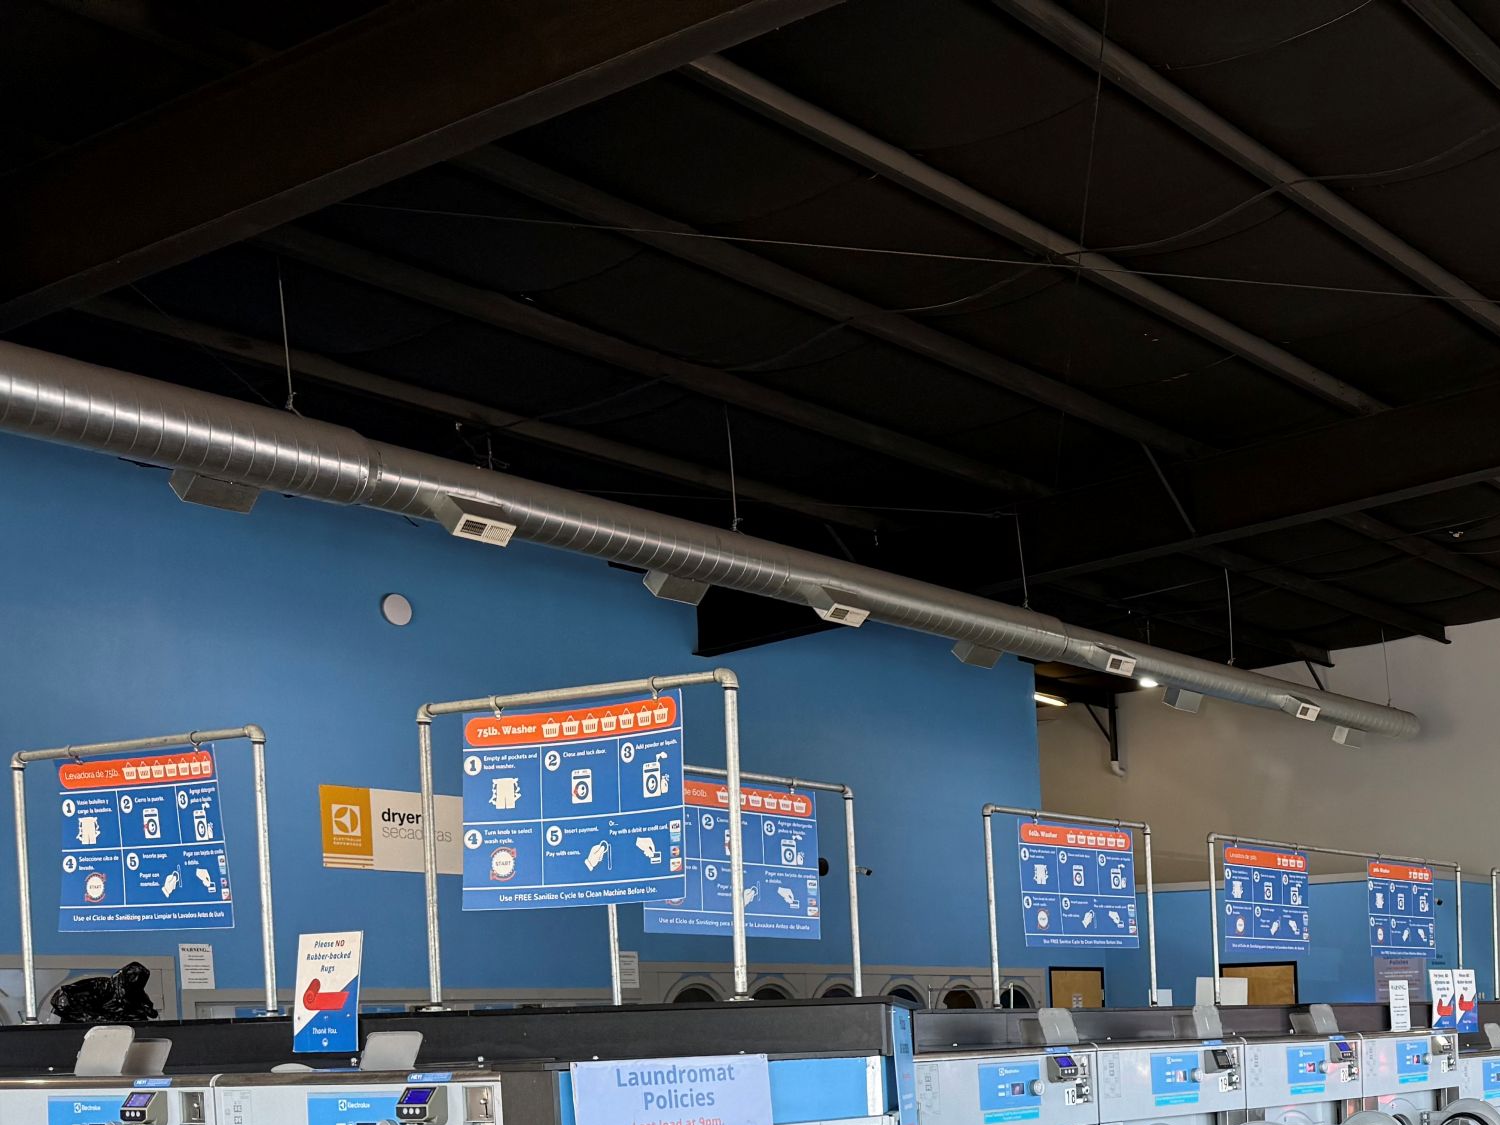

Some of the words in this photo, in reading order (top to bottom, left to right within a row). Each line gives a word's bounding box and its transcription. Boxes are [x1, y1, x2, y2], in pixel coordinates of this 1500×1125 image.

[477, 727, 500, 737] 75lb.
[502, 725, 536, 735] Washer
[624, 747, 631, 759] 3
[470, 760, 476, 771] 1
[548, 754, 557, 766] 2
[65, 771, 95, 780] Levadora
[106, 770, 119, 778] 75lb.
[382, 808, 421, 826] dryer
[382, 826, 452, 842] secadas
[468, 833, 477, 844] 4
[550, 831, 559, 842] 5
[560, 892, 576, 900] Cycle
[603, 887, 626, 896] Machine
[314, 940, 334, 948] Please
[307, 951, 351, 960] Rubber-backed
[321, 965, 335, 973] Rugs
[312, 1027, 327, 1035] Thank
[616, 1064, 735, 1087] Laundromat
[643, 1089, 715, 1110] Policies
[1066, 1090, 1075, 1104] 18
